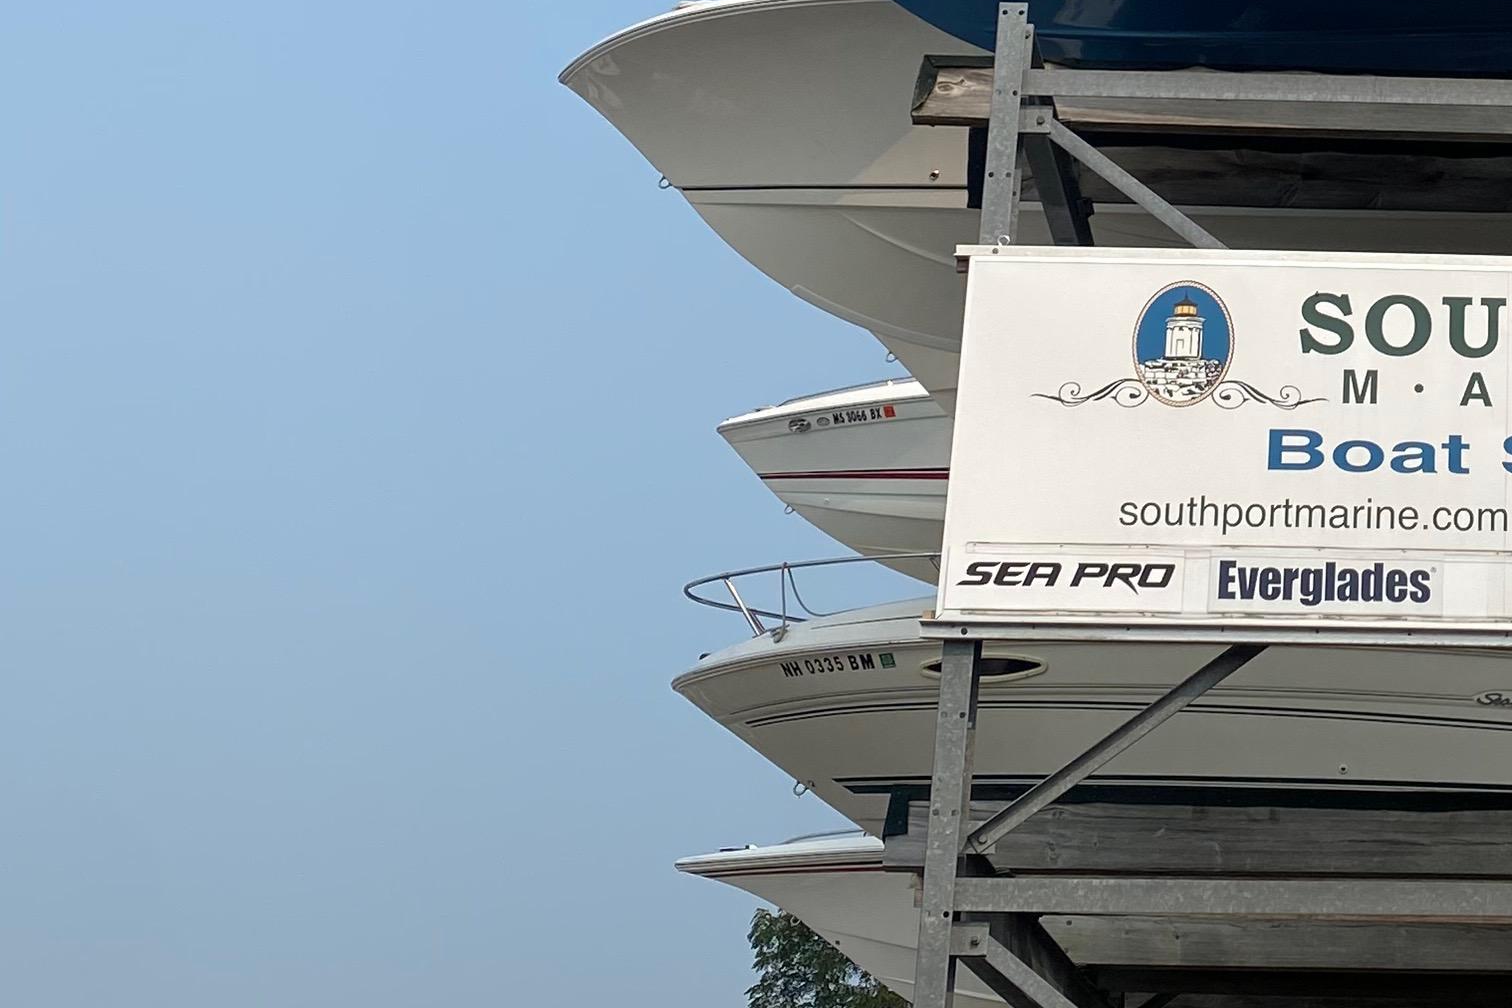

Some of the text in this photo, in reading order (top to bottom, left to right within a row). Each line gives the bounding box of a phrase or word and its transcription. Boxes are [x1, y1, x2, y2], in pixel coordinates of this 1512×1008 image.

[870, 407, 883, 420] BX
[1267, 428, 1471, 474] Boat
[1119, 495, 1509, 535] southportmarine.com
[955, 561, 1176, 596] SEA PRO
[1218, 559, 1432, 606] Everglades
[780, 653, 875, 677] NH 0335 BM
